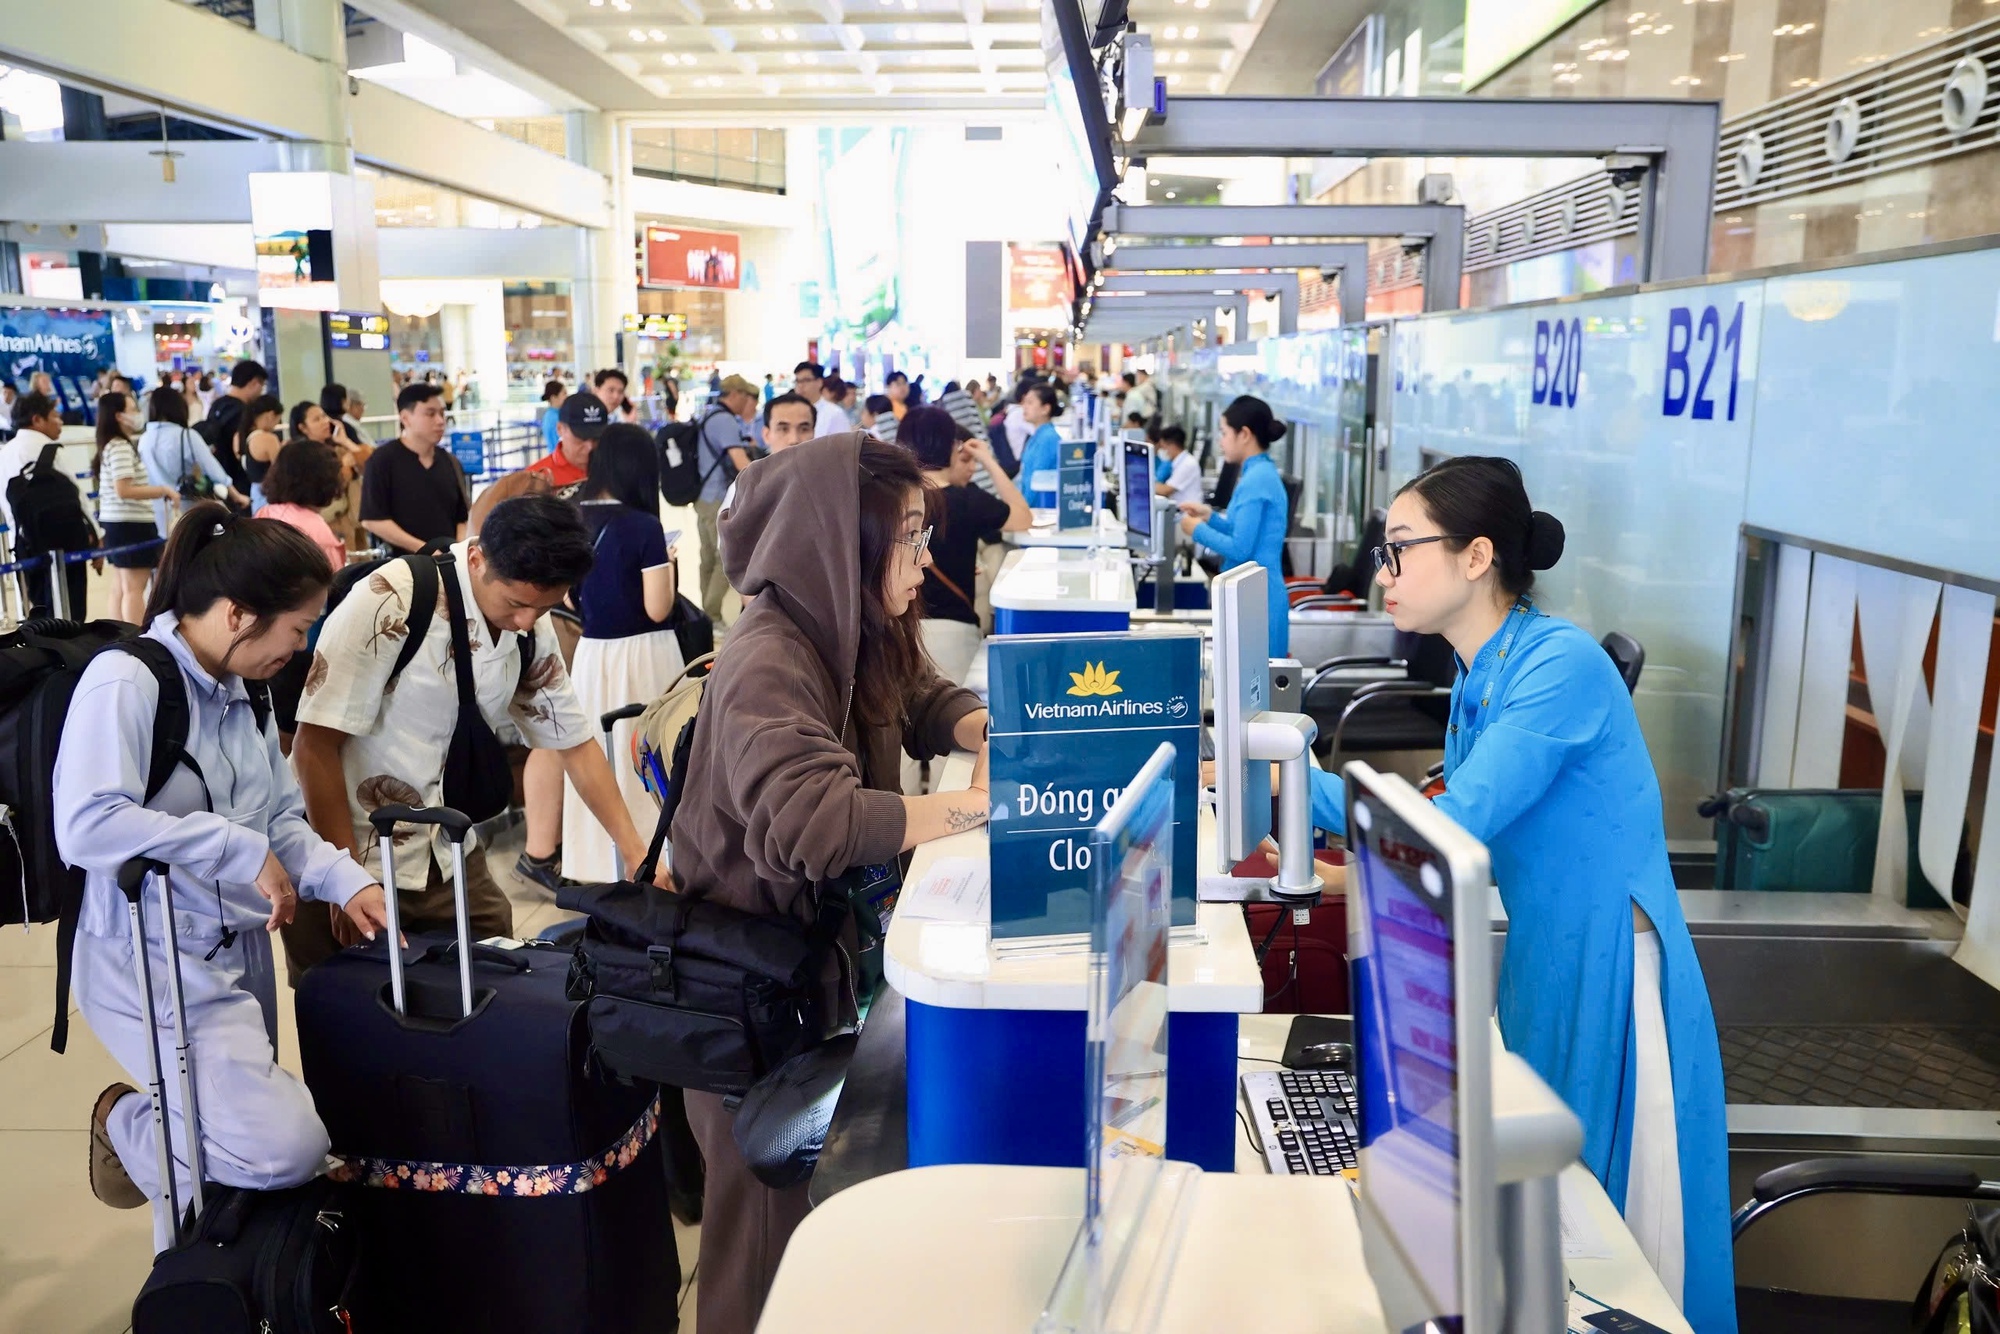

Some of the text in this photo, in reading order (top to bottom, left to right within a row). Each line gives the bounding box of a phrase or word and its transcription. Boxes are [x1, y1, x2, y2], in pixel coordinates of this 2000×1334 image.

[34, 333, 83, 354] Airlines
[1533, 317, 1581, 408] B20
[1663, 301, 1744, 421] B21
[1025, 700, 1163, 719] Vietnam Airlines
[1017, 782, 1094, 822] Đóng
